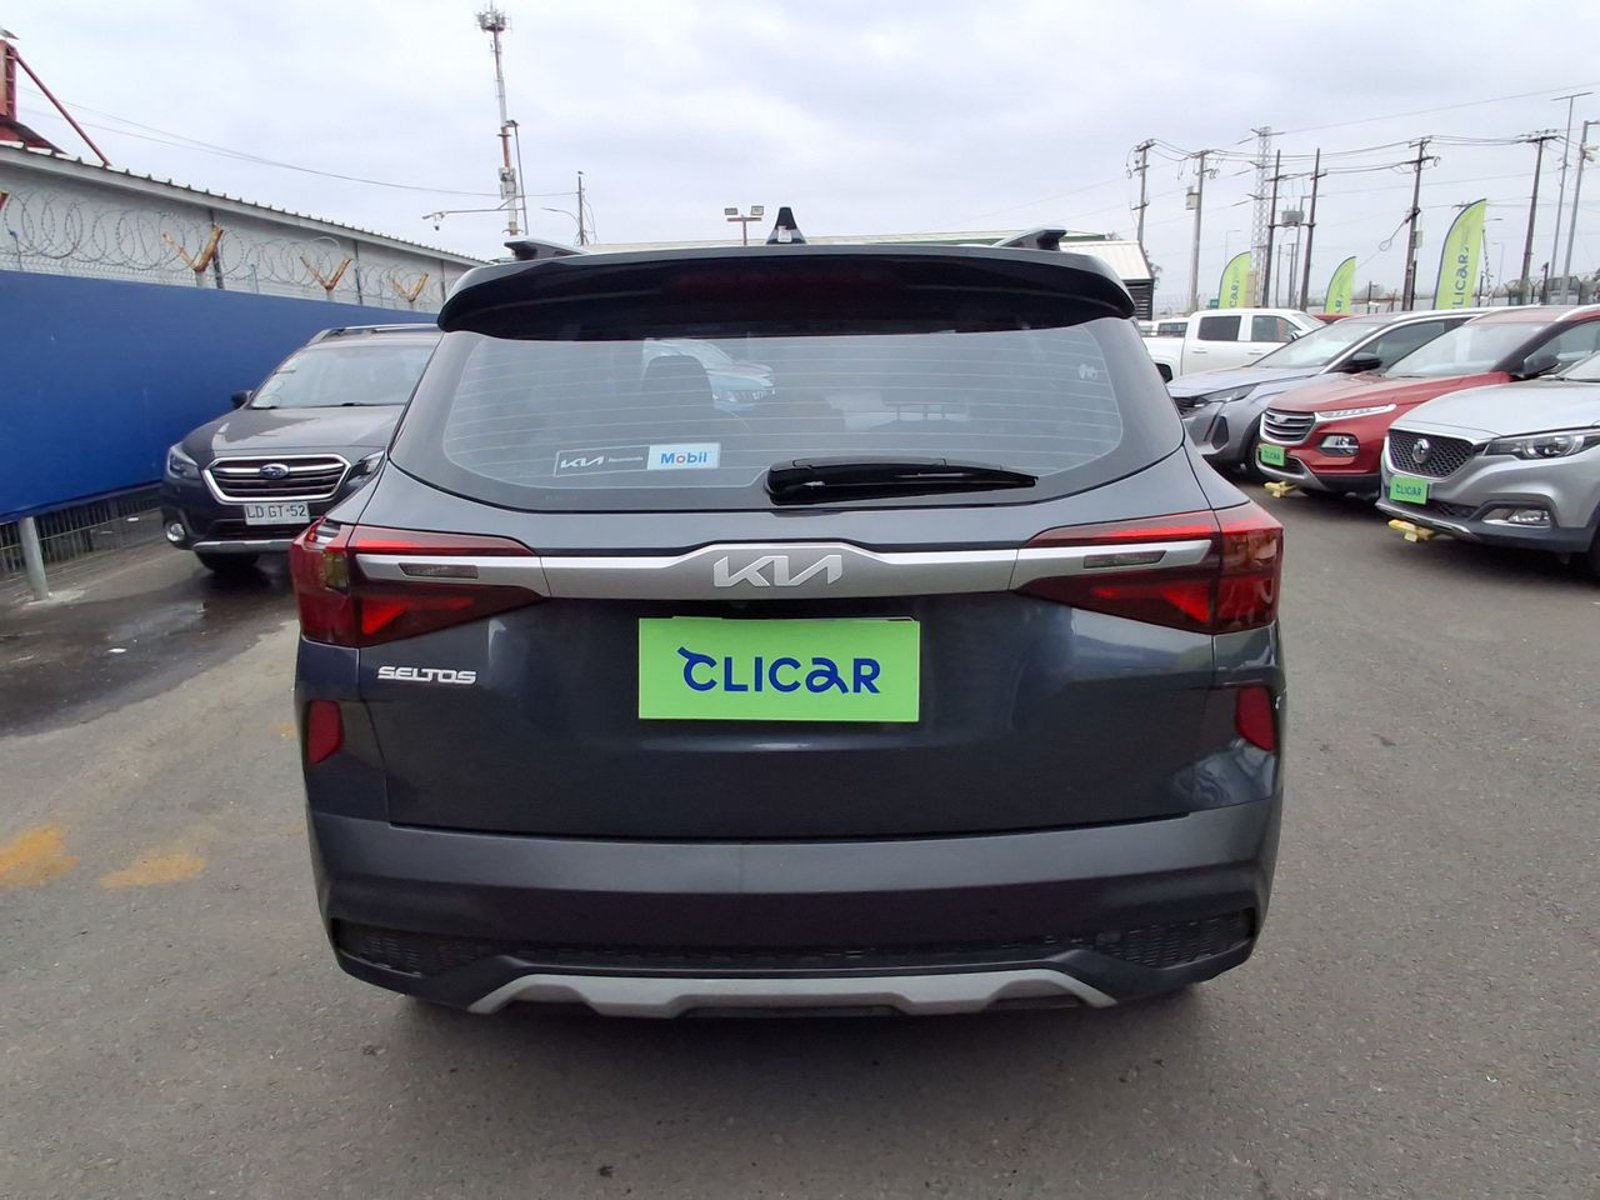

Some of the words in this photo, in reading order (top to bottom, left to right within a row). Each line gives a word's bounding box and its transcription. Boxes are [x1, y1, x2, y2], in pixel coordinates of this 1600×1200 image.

[660, 452, 708, 465] Mobil
[246, 505, 264, 518] LD
[713, 554, 843, 588] KIA
[377, 666, 477, 685] SELTOS
